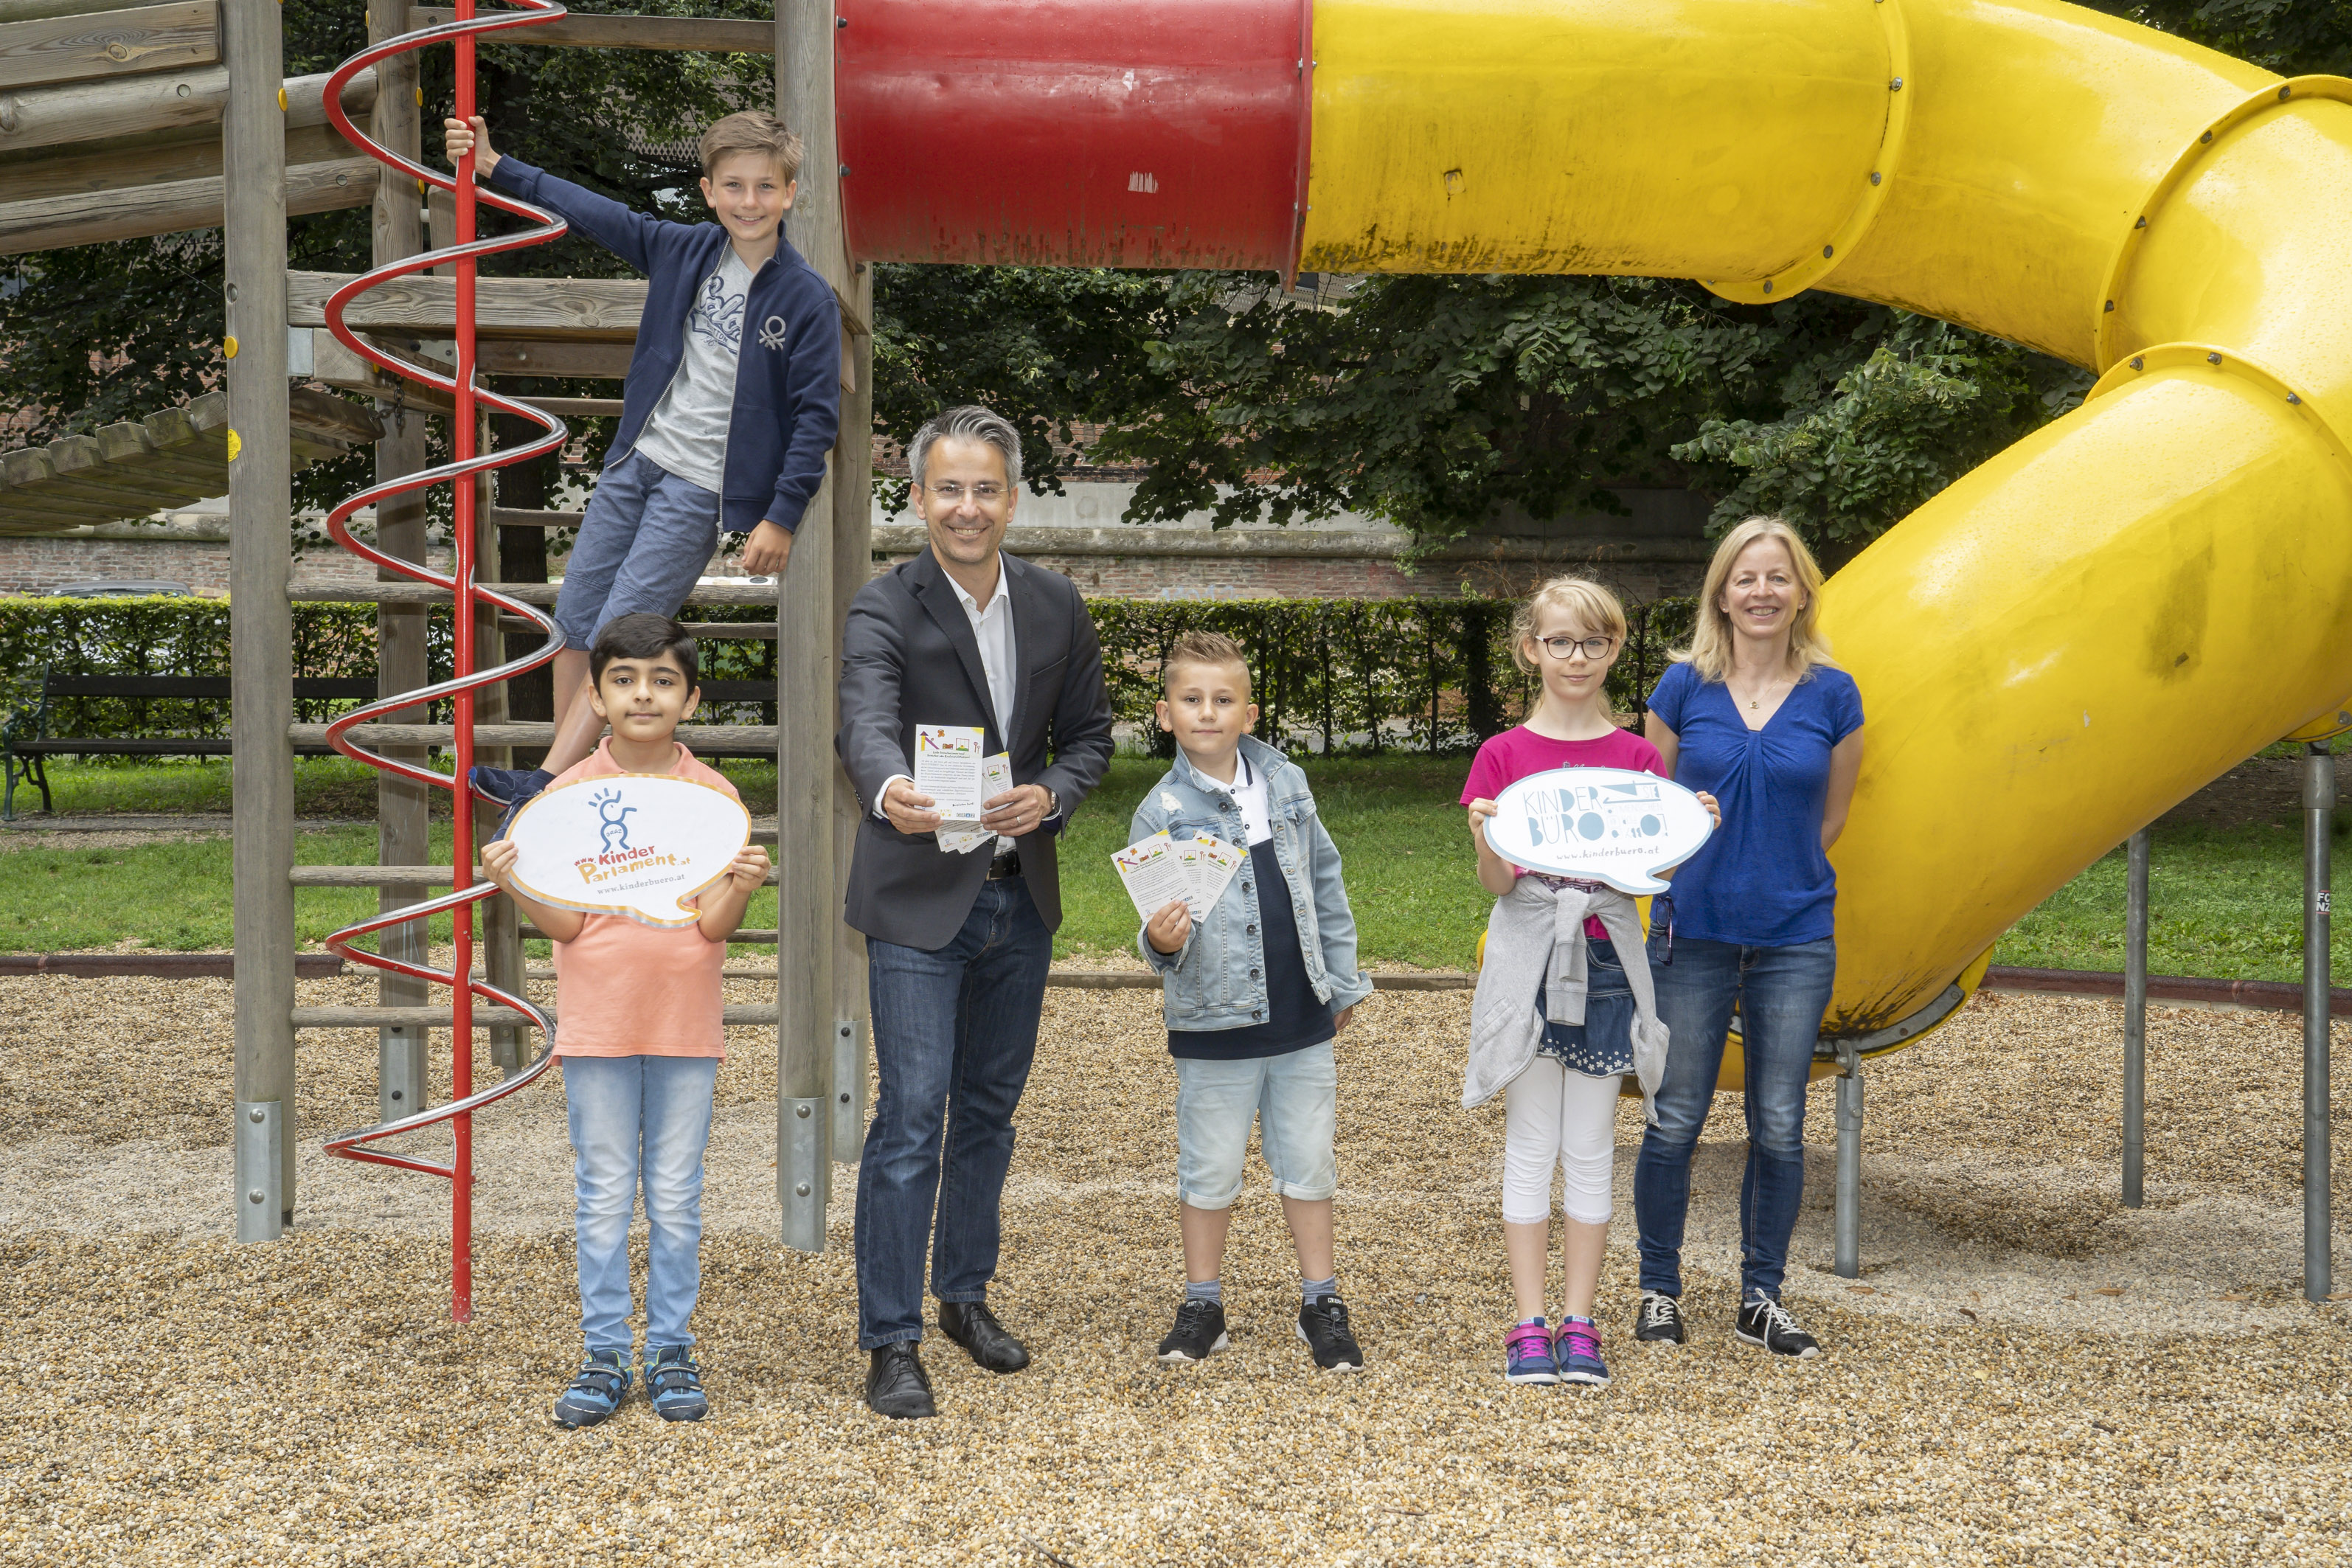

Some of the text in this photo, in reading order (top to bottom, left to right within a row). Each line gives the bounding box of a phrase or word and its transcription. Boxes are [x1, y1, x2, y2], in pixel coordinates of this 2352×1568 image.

[1523, 785, 1603, 816] KINDER
[1527, 812, 1605, 847] BÜRO
[1556, 846, 1660, 860] www.kinderbuero.at
[597, 874, 685, 895] www.kinderbuero.at
[602, 1363, 620, 1373] FILA
